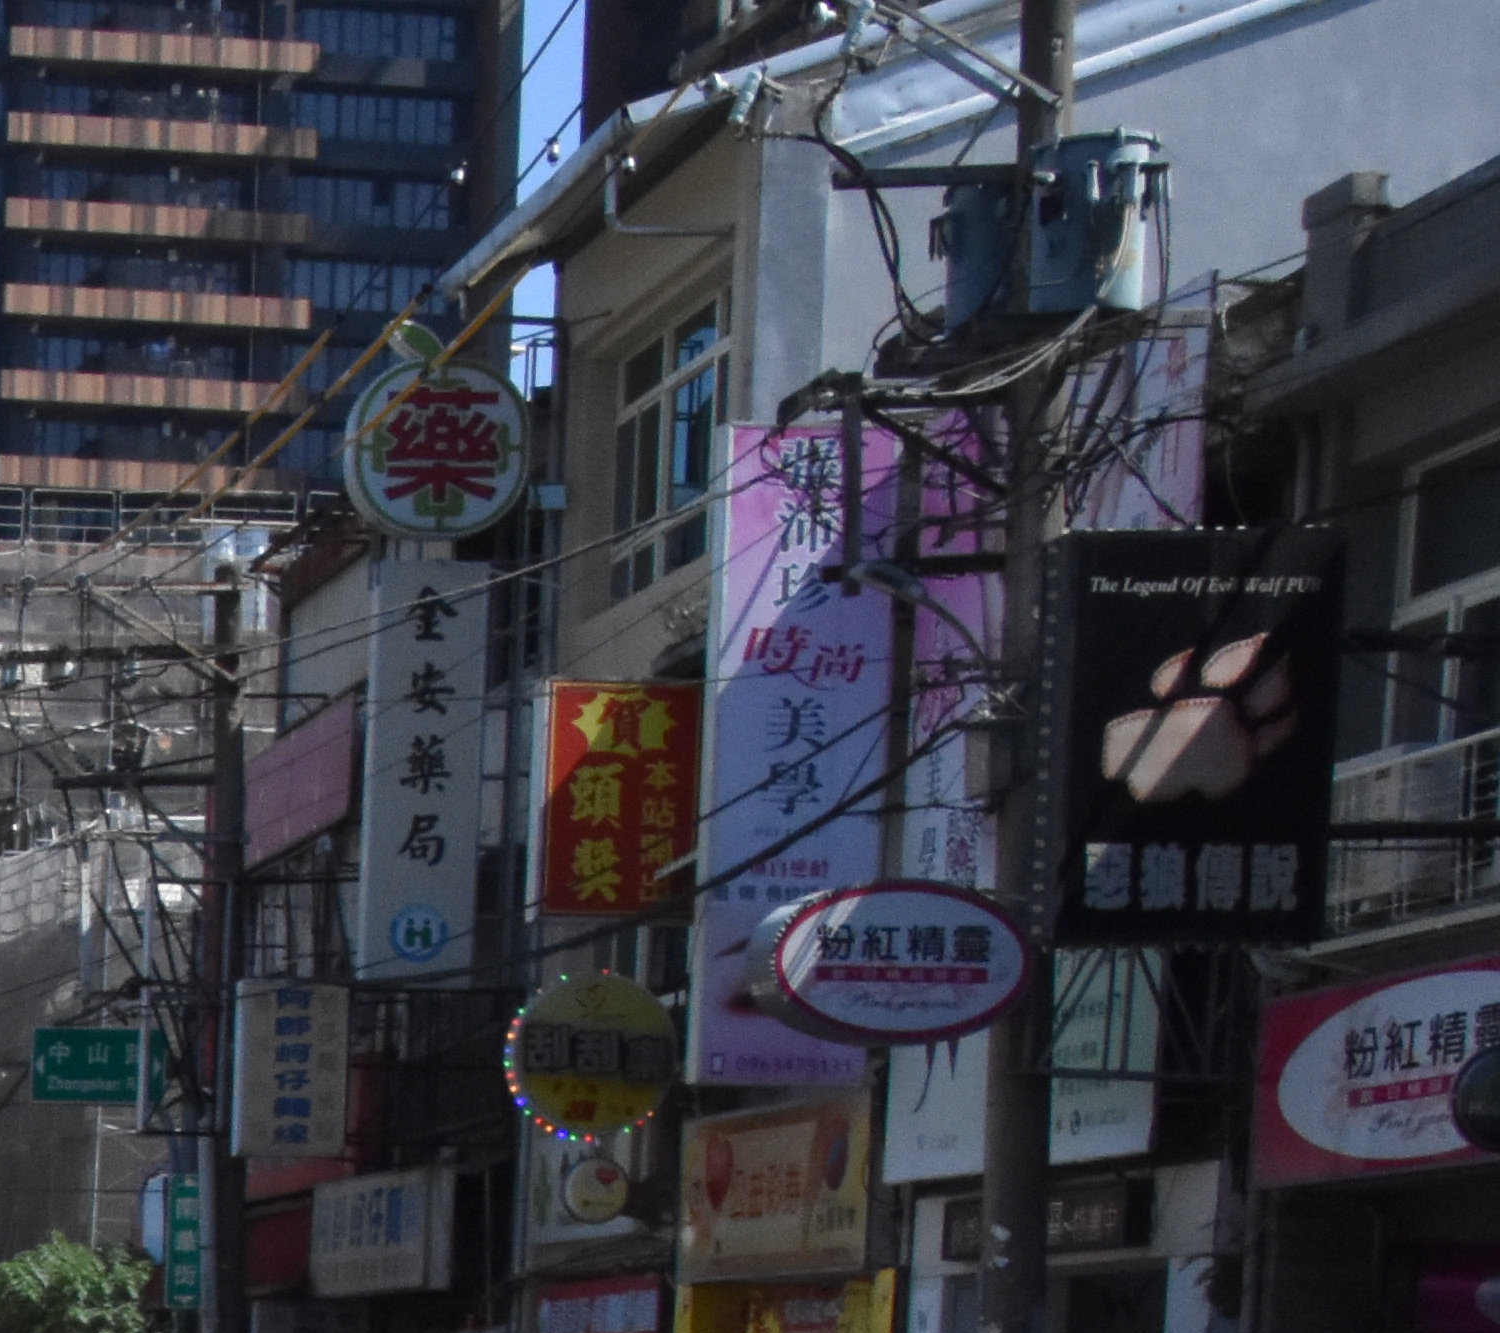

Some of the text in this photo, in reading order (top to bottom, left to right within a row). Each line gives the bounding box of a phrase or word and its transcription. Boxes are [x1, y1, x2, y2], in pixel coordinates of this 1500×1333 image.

[384, 388, 500, 502] 藥
[1090, 575, 1120, 594] The
[1122, 575, 1179, 598] Legend
[1181, 575, 1205, 598] Of
[744, 625, 866, 685] 時尚
[397, 586, 457, 867] 金安藥局
[761, 696, 825, 817] 美學
[565, 762, 625, 904] 頭獎
[1084, 842, 1298, 911] 惡狼傳說
[817, 923, 993, 963] 粉紅精靈
[47, 1075, 120, 1092] Zhongshan
